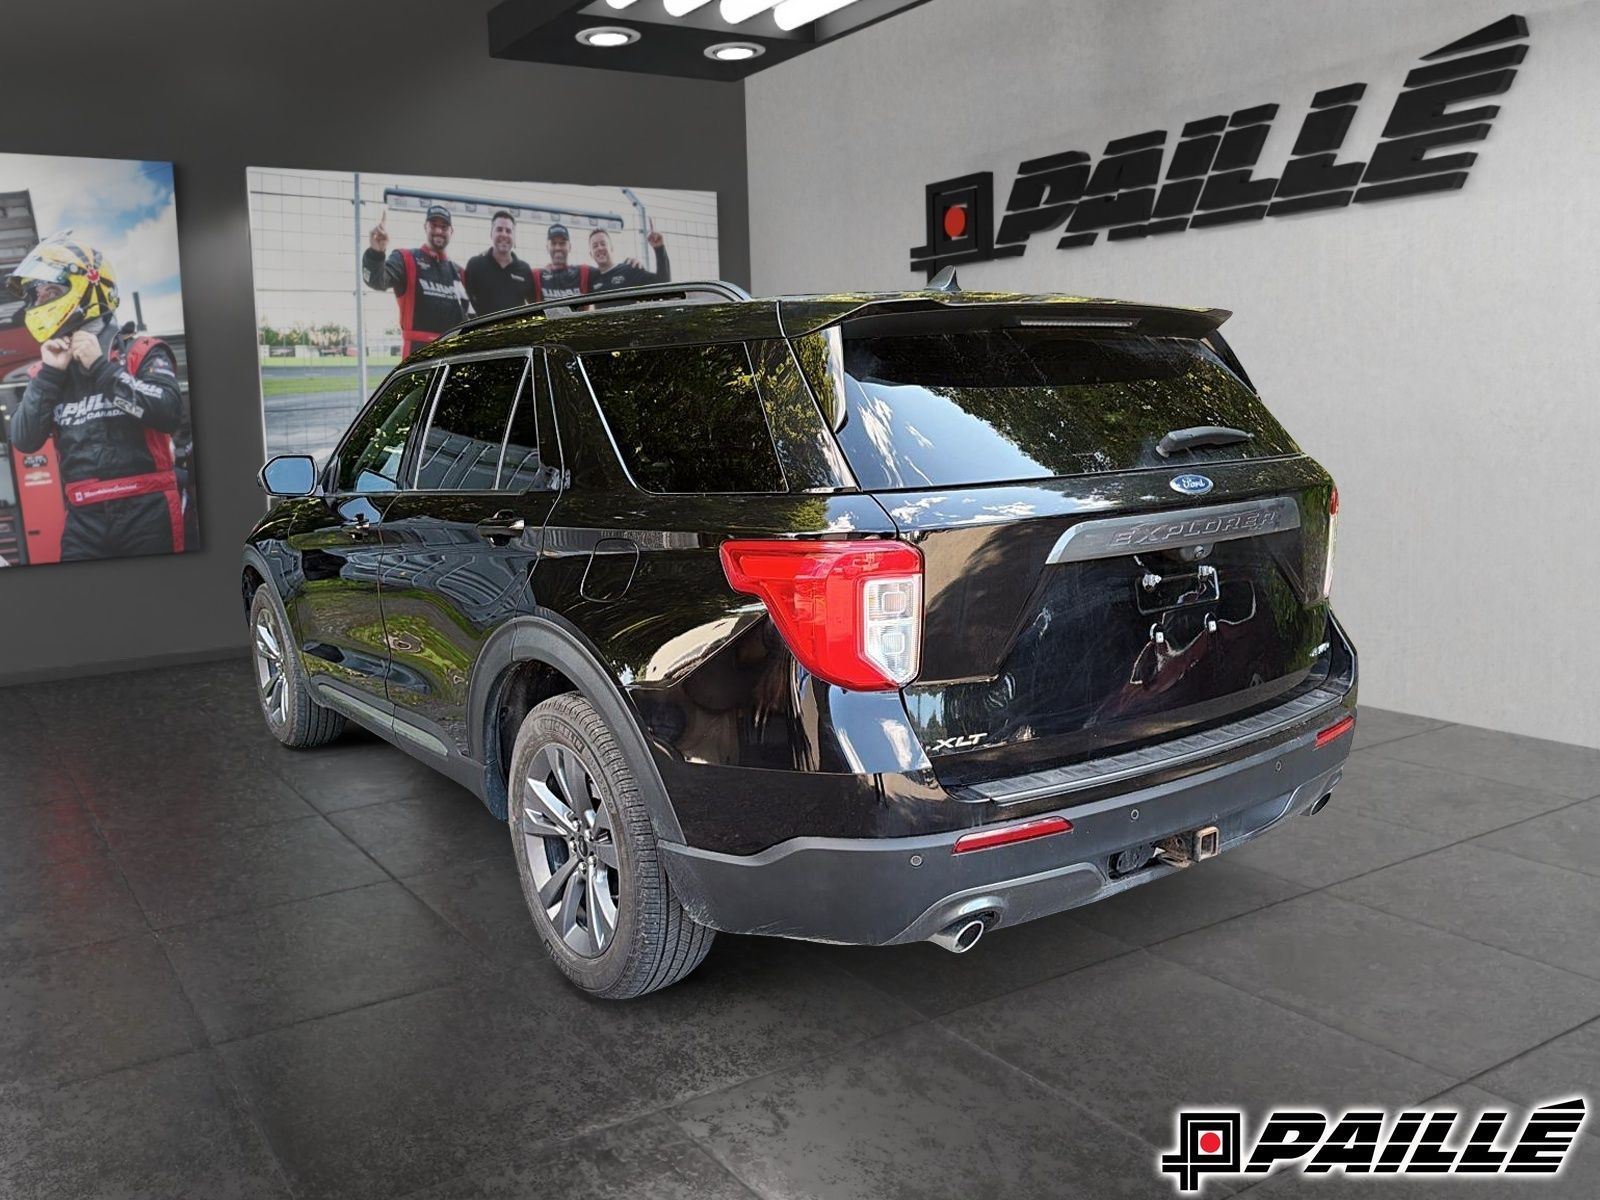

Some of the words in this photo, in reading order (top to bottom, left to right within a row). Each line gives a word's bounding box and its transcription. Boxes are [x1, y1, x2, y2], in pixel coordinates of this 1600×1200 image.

[996, 14, 1531, 250] PAILLÉ
[1110, 510, 1277, 546] EXPLORER
[931, 732, 988, 751] XLT
